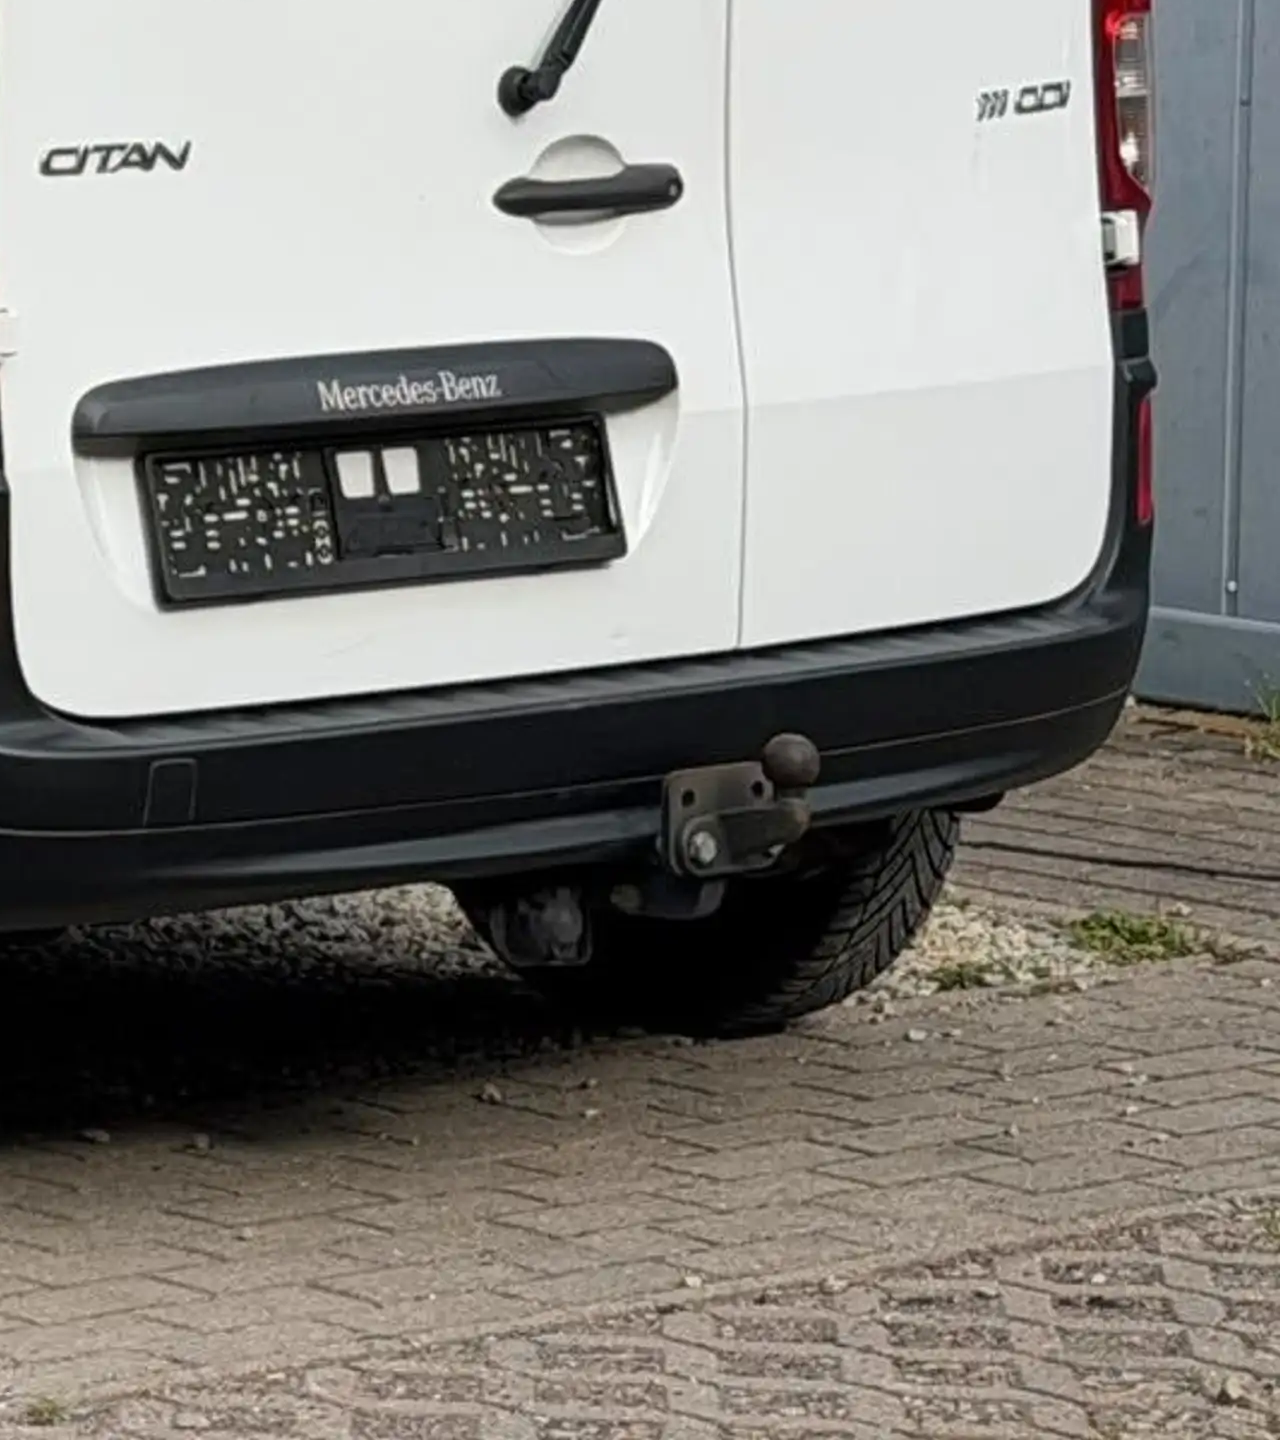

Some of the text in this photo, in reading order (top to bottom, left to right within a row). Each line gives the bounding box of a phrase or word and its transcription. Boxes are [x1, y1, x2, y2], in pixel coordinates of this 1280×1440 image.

[1013, 78, 1071, 115] CDI
[39, 139, 192, 177] CITAN
[316, 369, 504, 412] Mercedes-Benz
